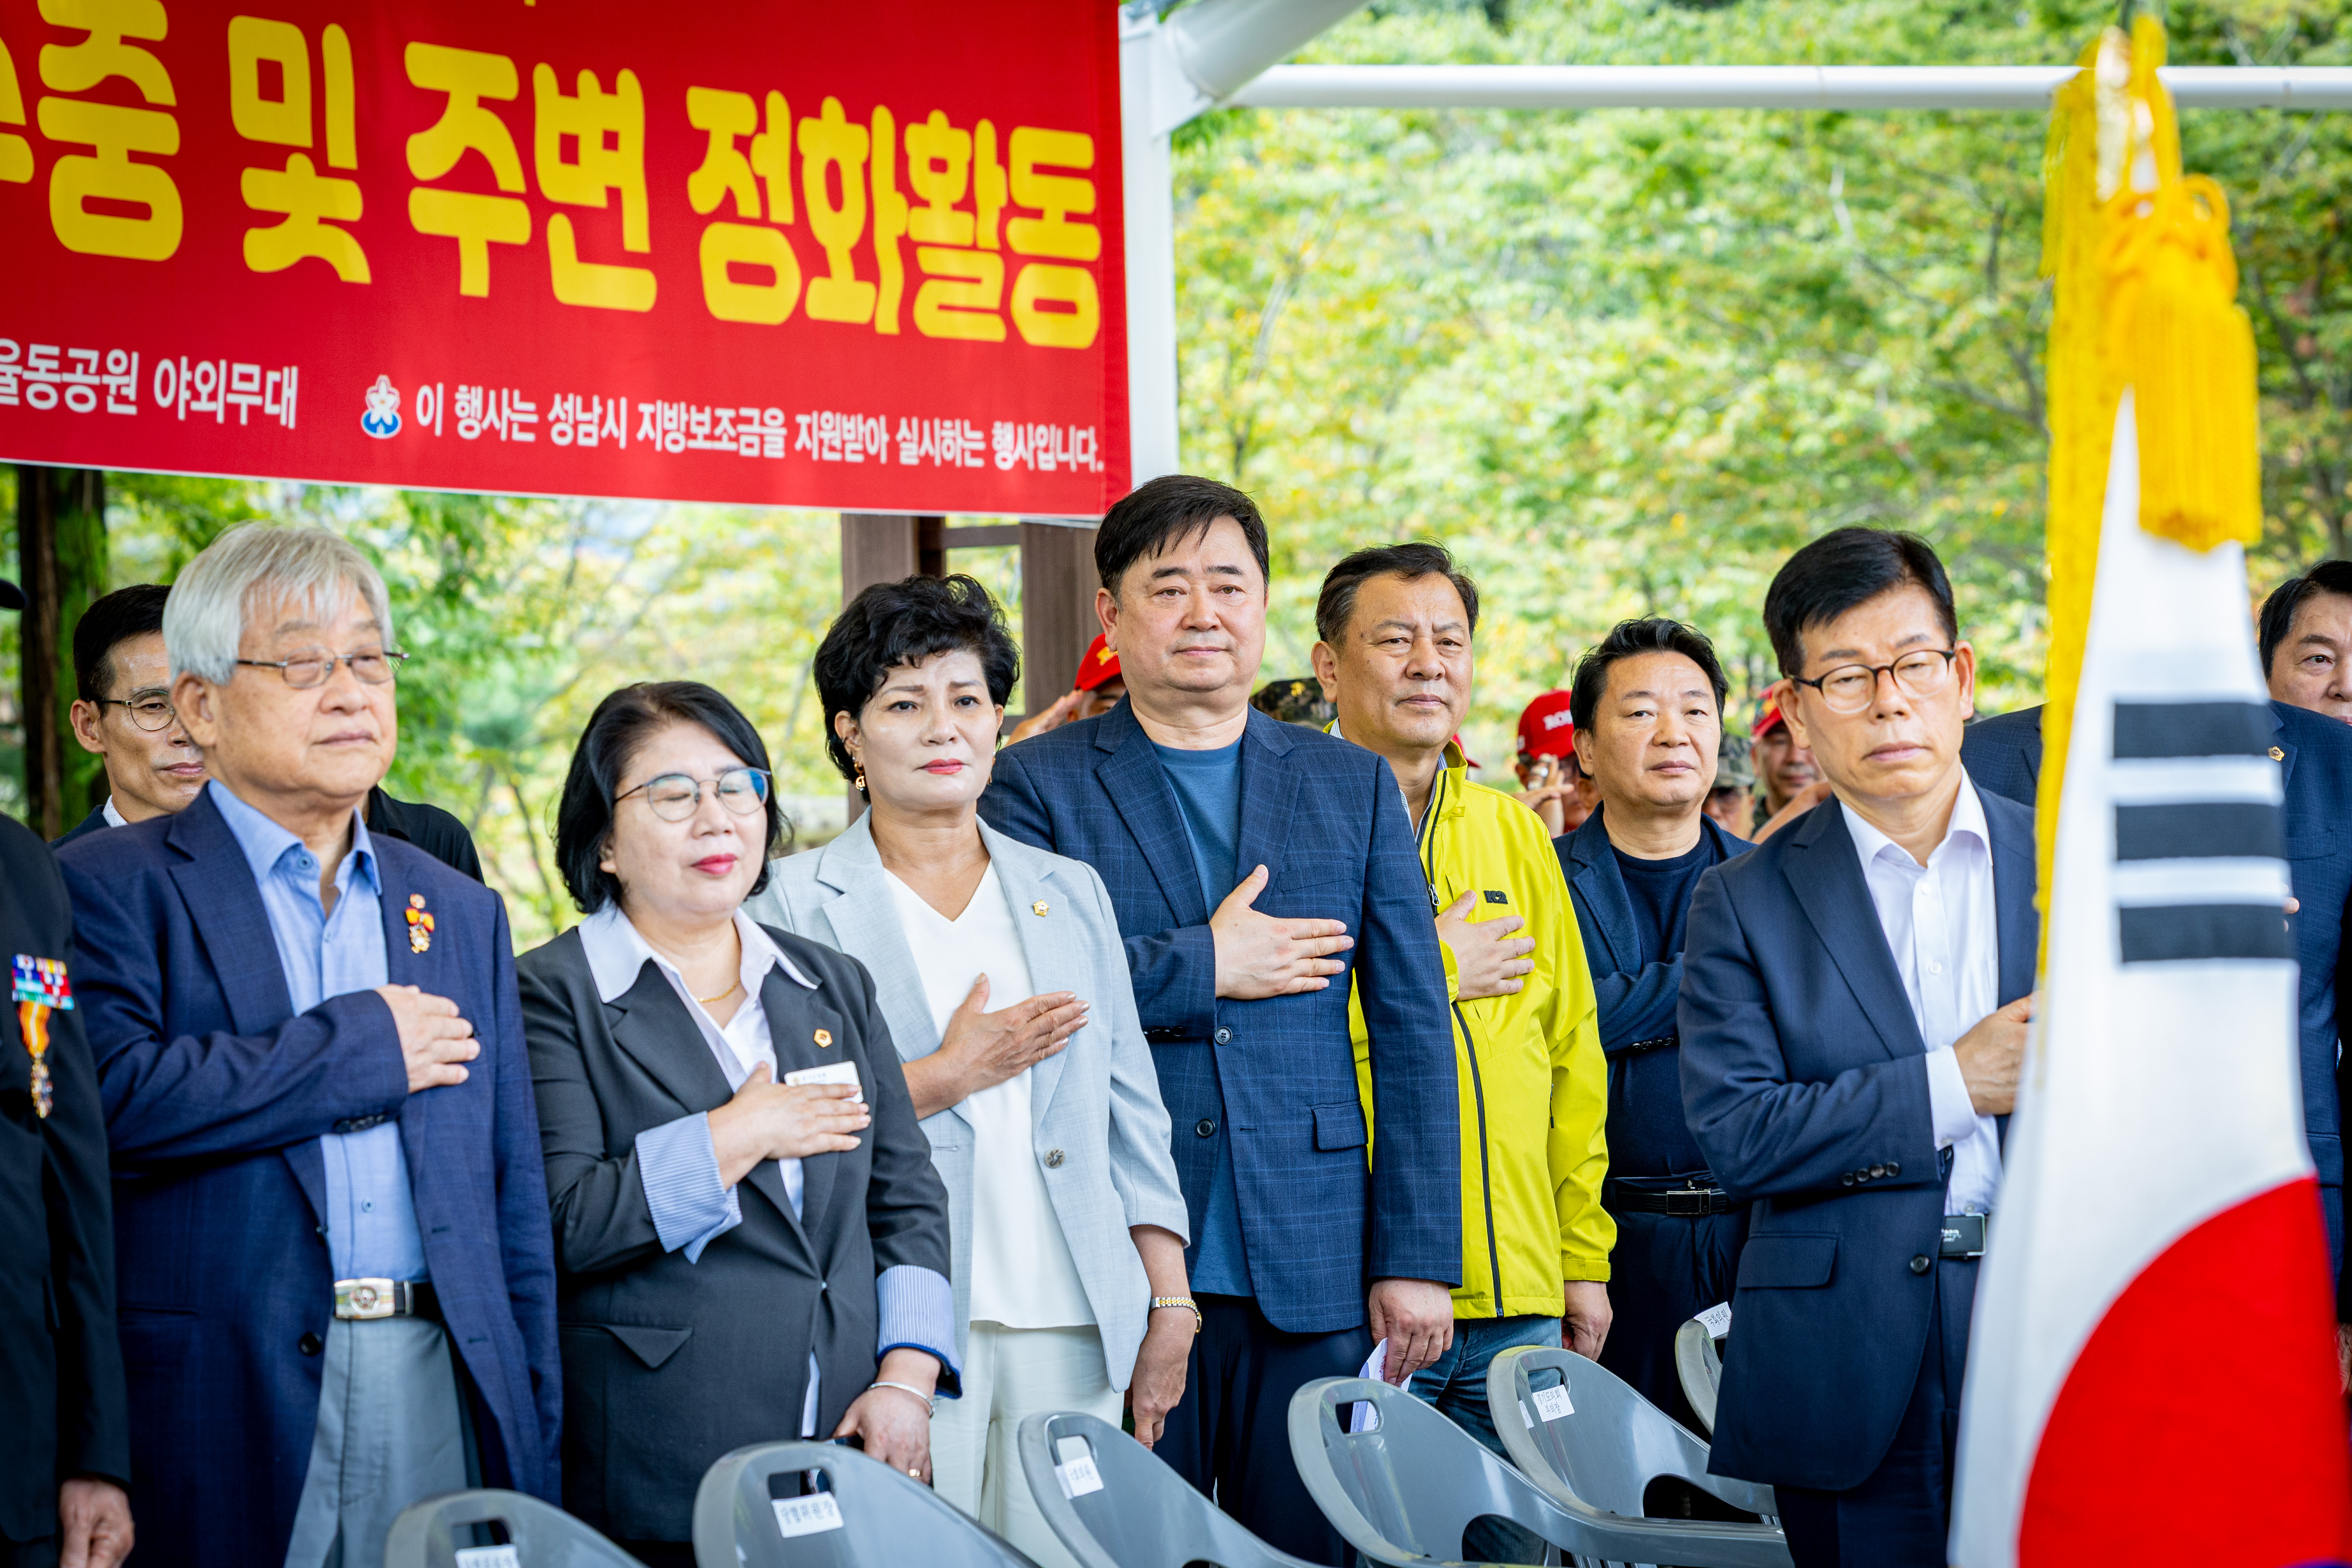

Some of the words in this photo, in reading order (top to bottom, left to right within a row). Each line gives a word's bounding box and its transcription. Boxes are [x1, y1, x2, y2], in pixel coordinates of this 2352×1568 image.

[0, 0, 183, 262] 중
[228, 15, 372, 284] 및
[404, 41, 658, 313] 주변
[686, 86, 1102, 349] 정화활동
[154, 356, 298, 429] 야외무대
[416, 383, 443, 436] 이
[455, 385, 539, 442] 행사는
[548, 393, 627, 449] 성남시
[636, 400, 787, 458] 지방보조금을
[794, 411, 890, 464] 지원받아
[896, 416, 986, 467] 실시하는
[991, 421, 1104, 472] 행사입니다.
[1483, 890, 1508, 905] K2
[1705, 1309, 1731, 1327] 국회의원
[1536, 1388, 1562, 1405] 경기도의회
[1545, 1402, 1561, 1416] 부의장
